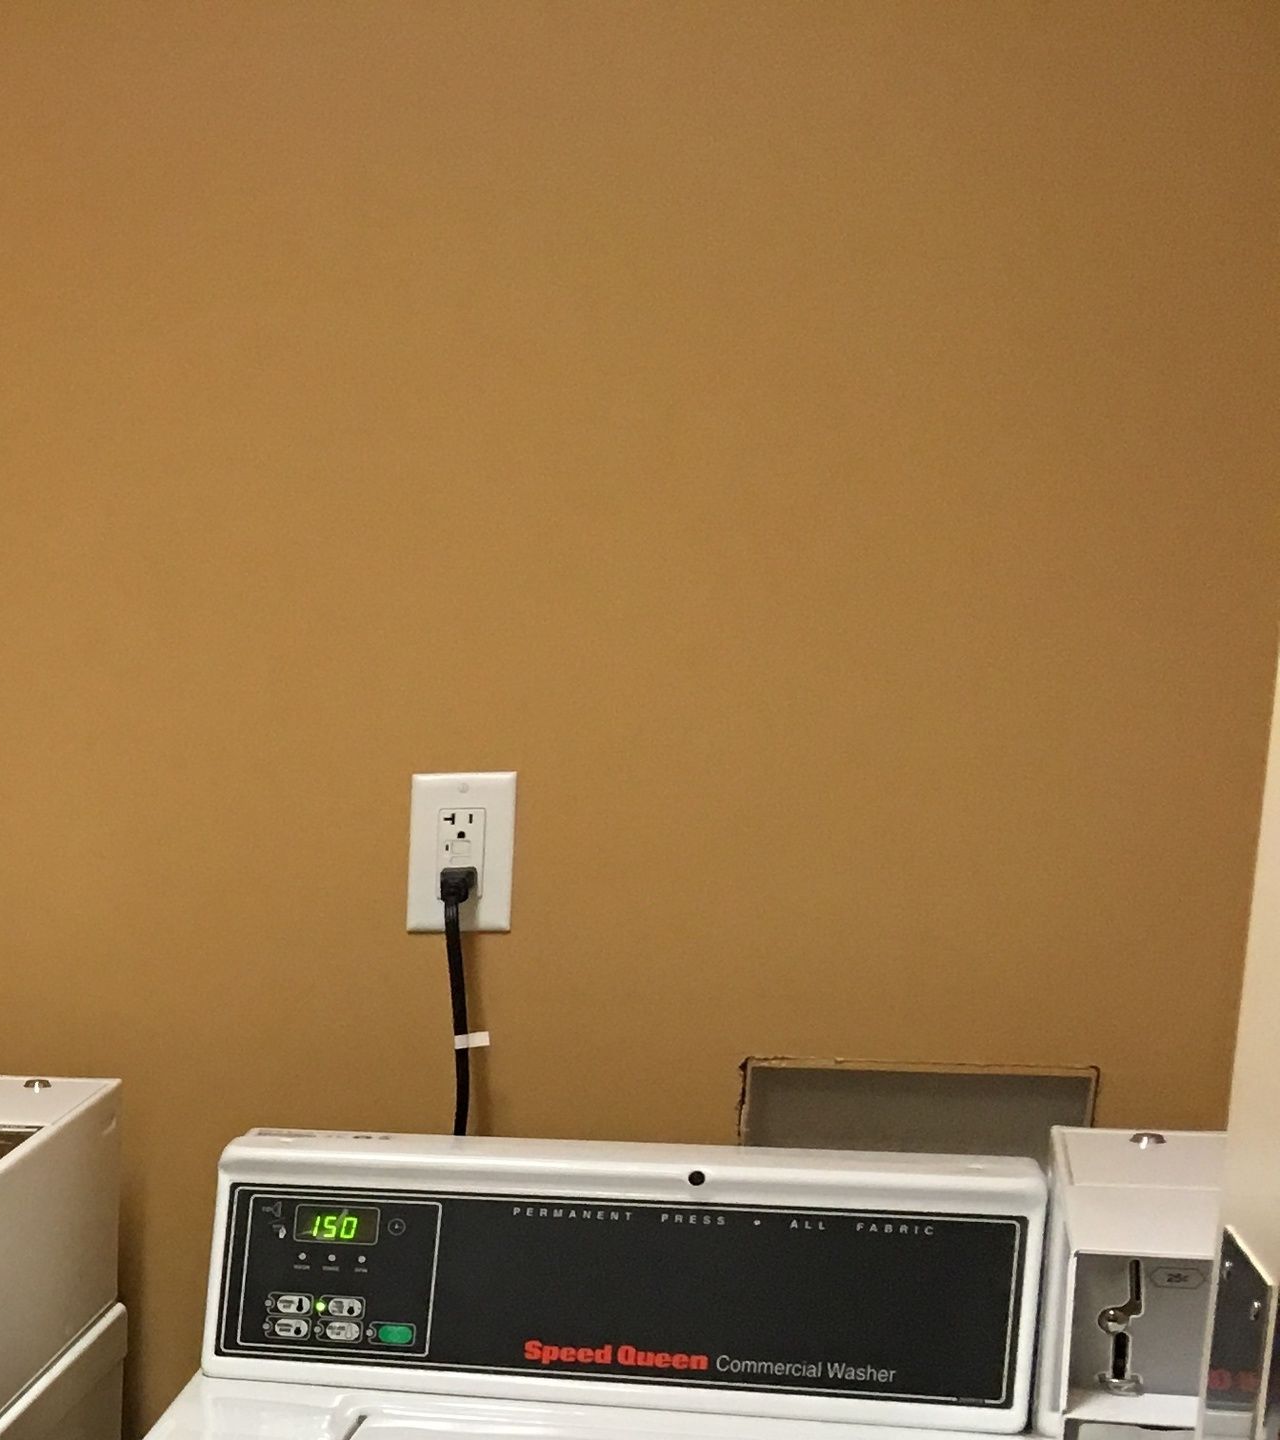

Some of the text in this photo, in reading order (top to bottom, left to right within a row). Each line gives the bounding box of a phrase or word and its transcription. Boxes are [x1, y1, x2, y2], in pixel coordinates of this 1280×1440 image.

[312, 1215, 358, 1239] 150
[513, 1206, 936, 1236] PERMANENT PRESS ALL FABRIC
[524, 1340, 896, 1383] Speed Queen Commercial Washer
